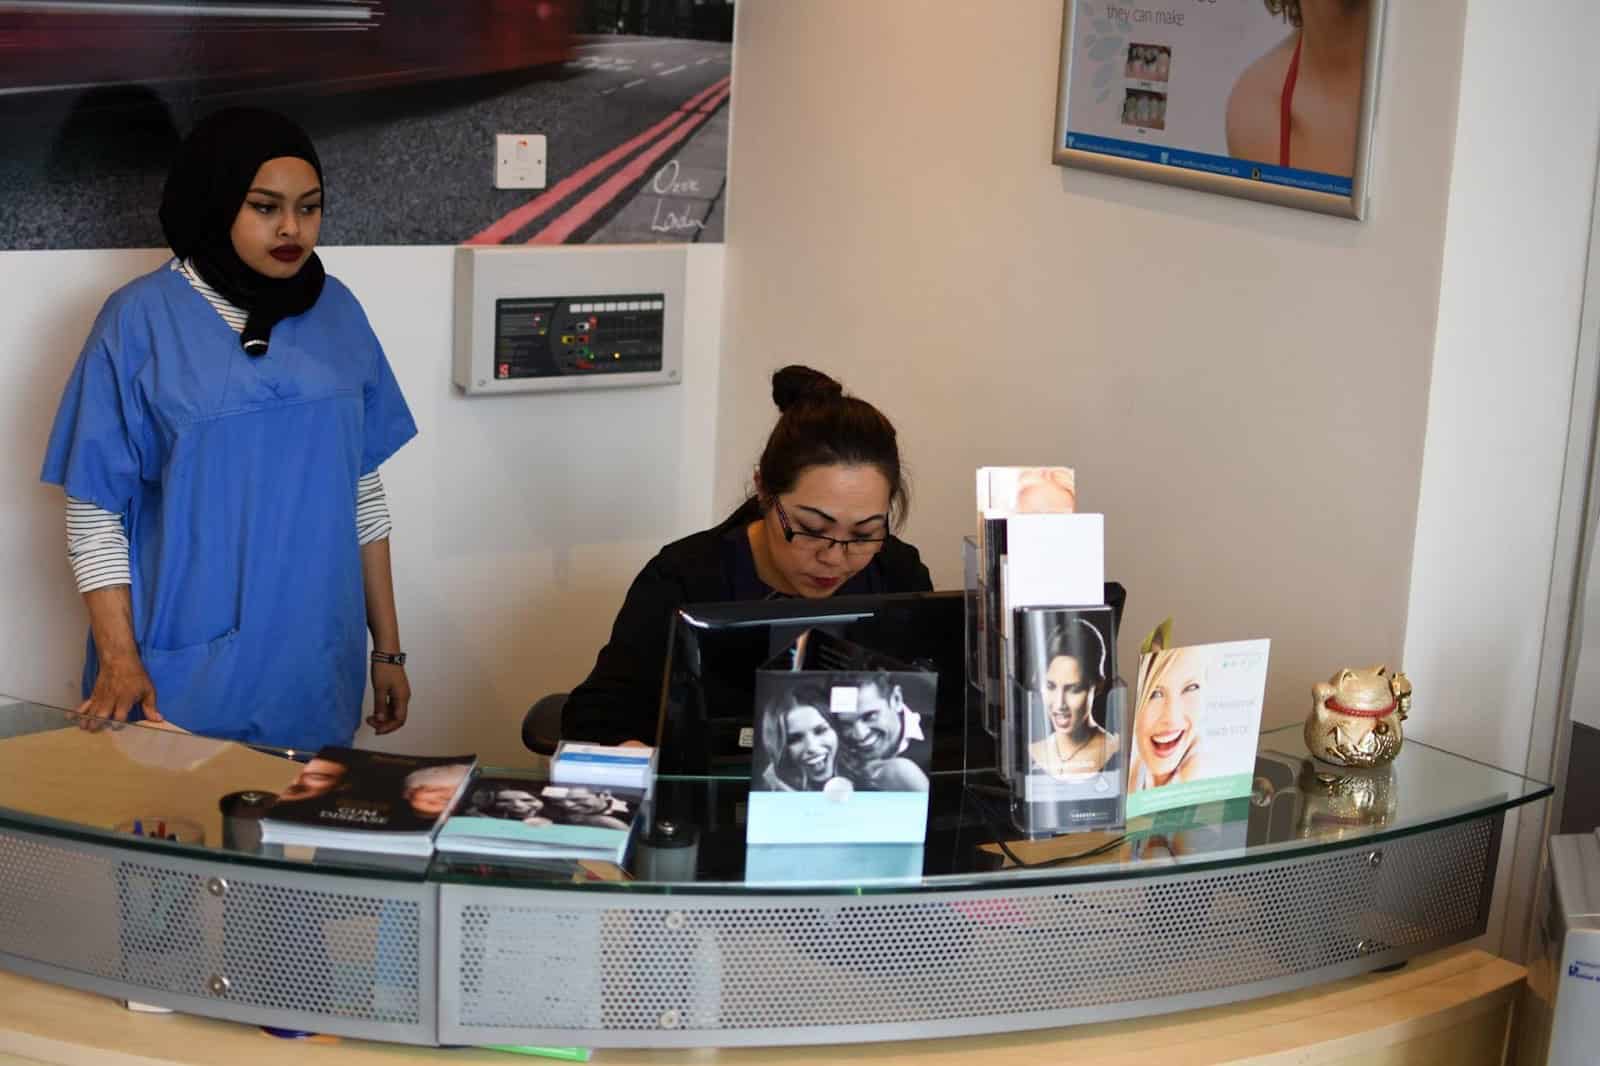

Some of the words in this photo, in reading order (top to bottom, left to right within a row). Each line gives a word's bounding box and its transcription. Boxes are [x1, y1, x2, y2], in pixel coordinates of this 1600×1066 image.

[1106, 4, 1134, 25] they
[1134, 8, 1153, 23] can
[1155, 8, 1185, 26] make
